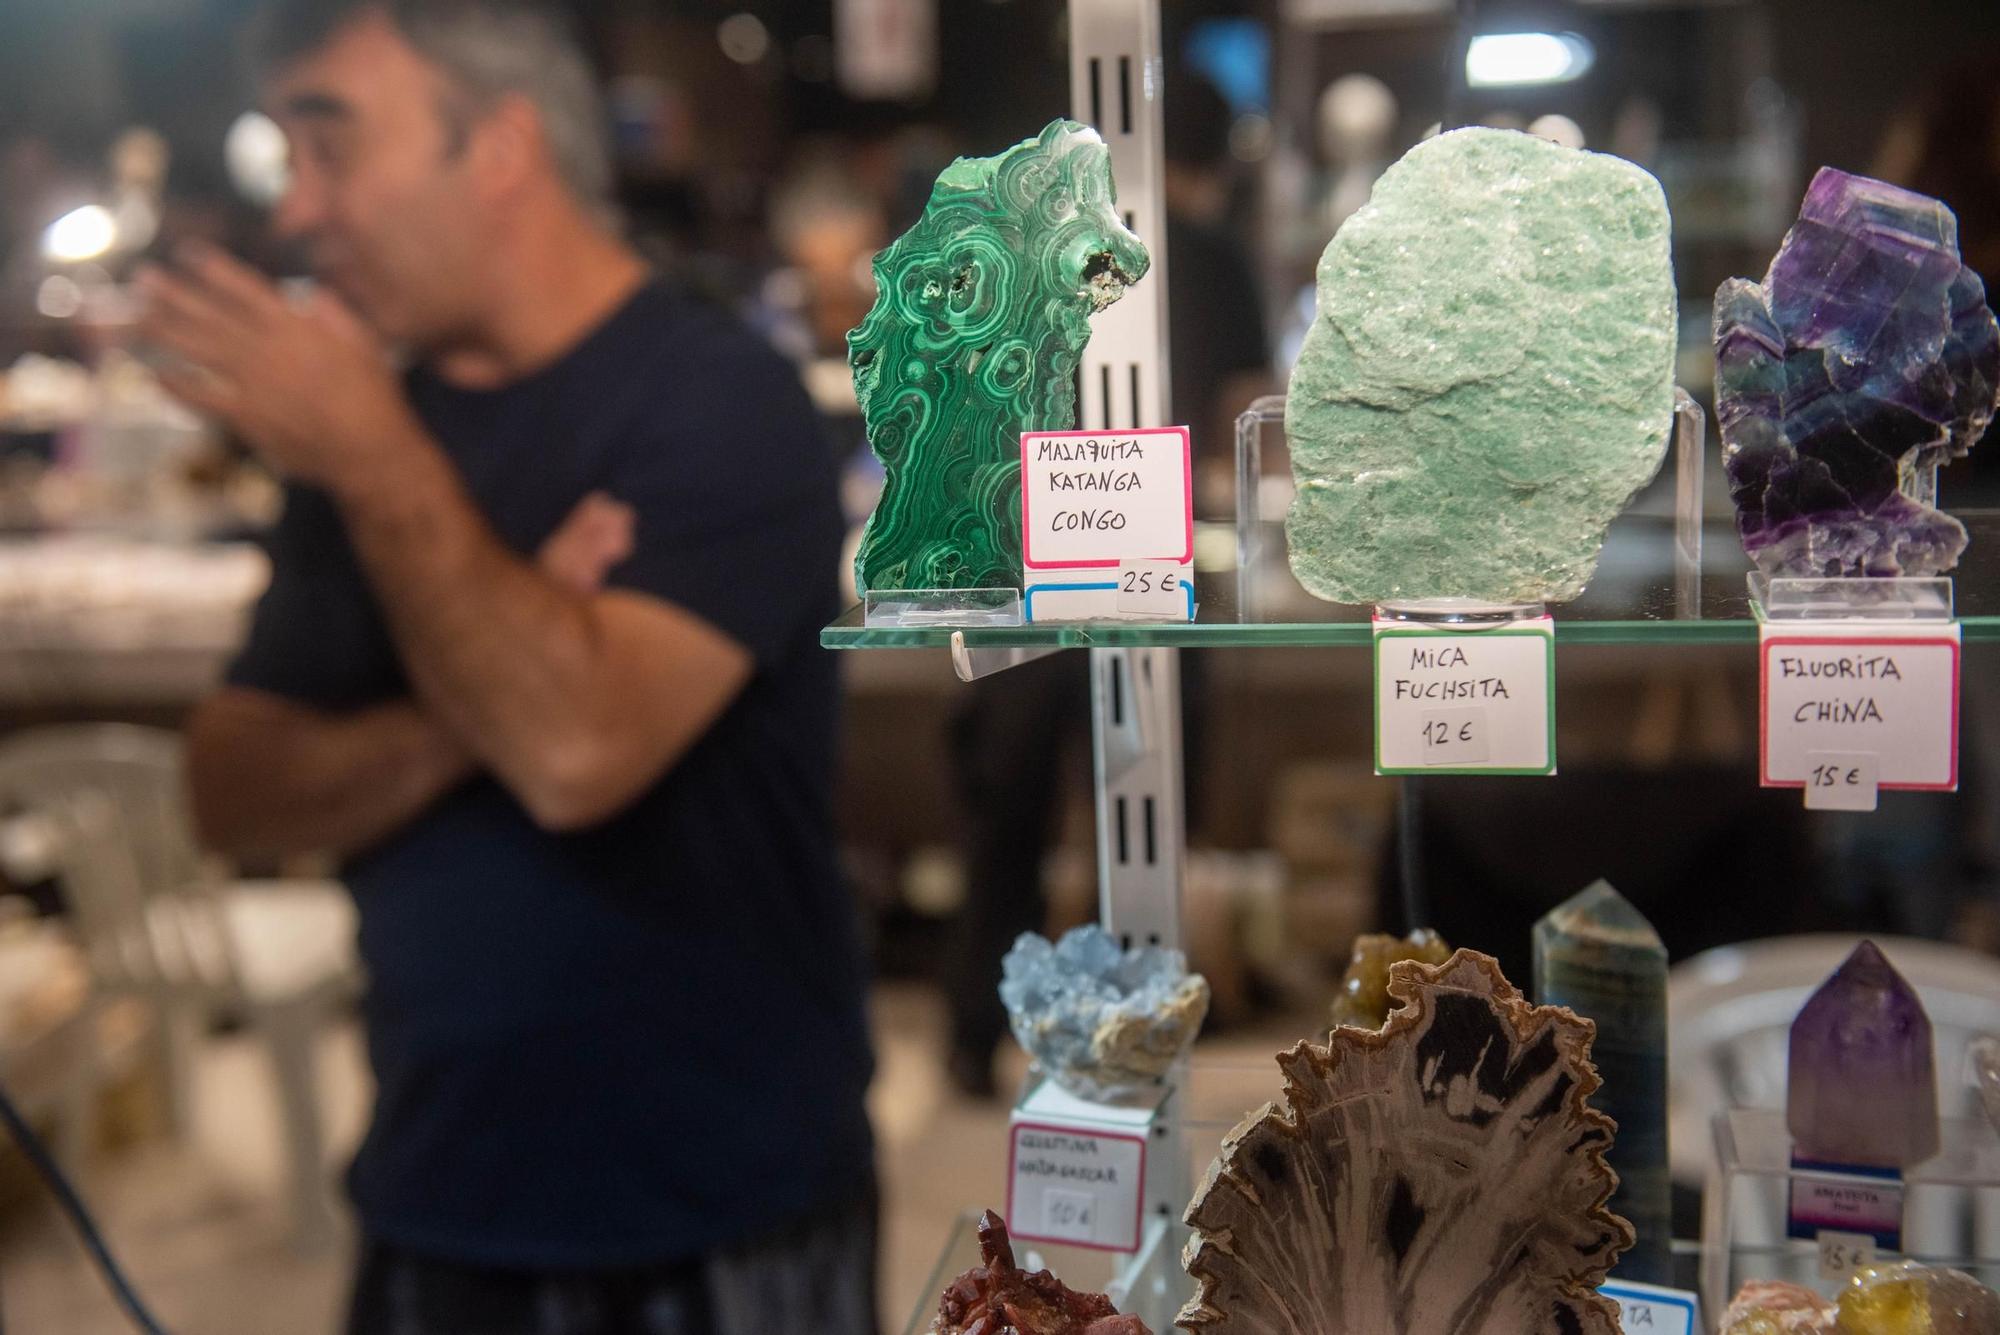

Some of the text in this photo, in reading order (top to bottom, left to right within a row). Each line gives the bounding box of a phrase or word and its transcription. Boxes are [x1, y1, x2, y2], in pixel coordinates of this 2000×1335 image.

[1037, 439, 1144, 462] MALAQUITA
[1050, 469, 1142, 492] KATANGA
[1051, 509, 1126, 532] CONGO
[1123, 571, 1176, 593] 25 €
[1410, 647, 1469, 670] MICA
[1780, 655, 1902, 680] FLUORITA
[1395, 678, 1510, 701] FUCHSITA
[1793, 697, 1884, 723] CHINA
[1422, 720, 1473, 747] 12 €
[1812, 764, 1860, 787] 15 €
